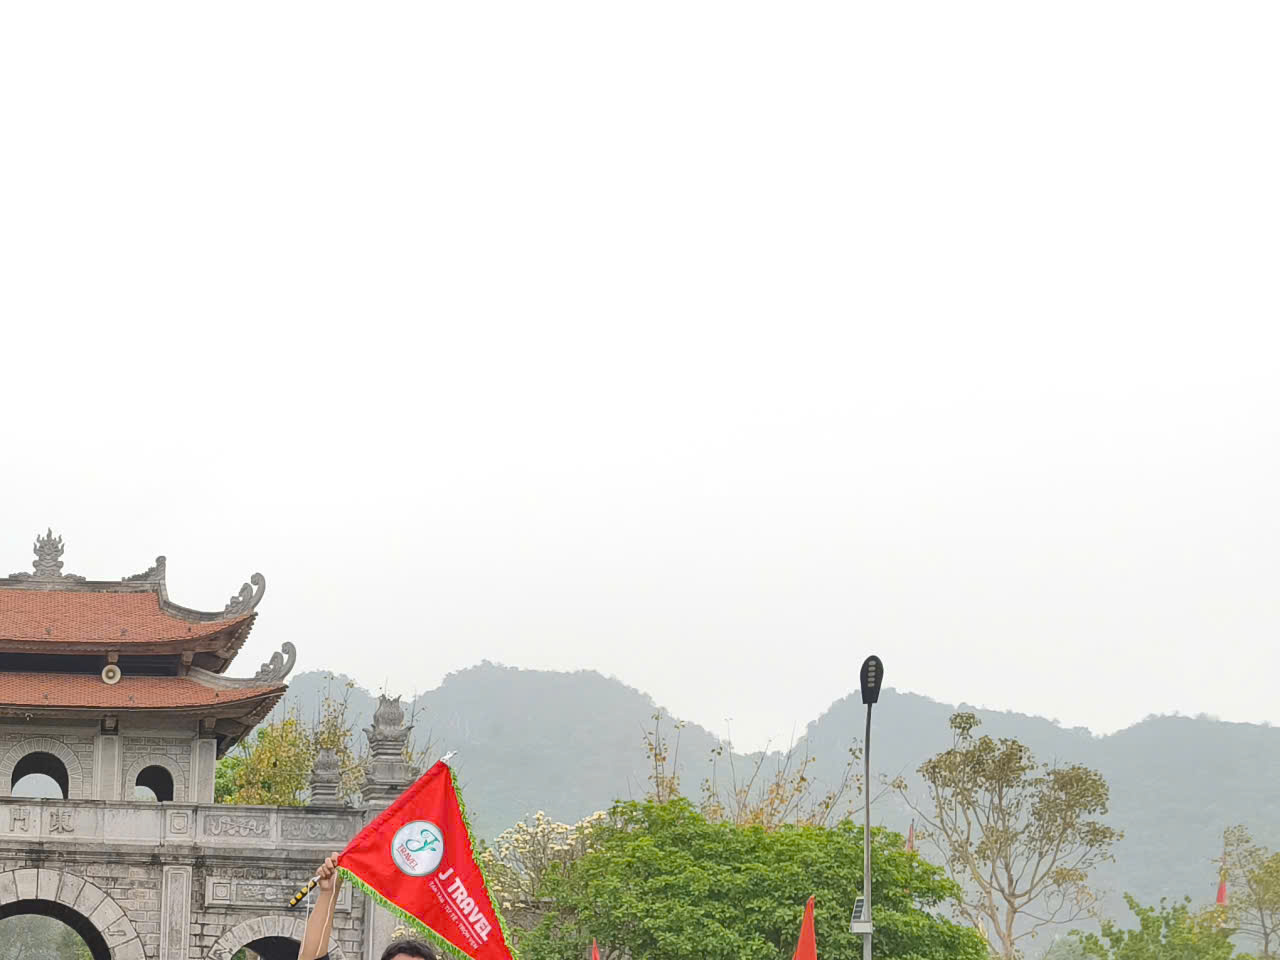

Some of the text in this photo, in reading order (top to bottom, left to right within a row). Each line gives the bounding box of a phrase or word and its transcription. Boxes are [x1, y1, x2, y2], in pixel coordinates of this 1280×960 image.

[397, 844, 419, 871] TRAVEL
[438, 867, 492, 942] J TRAVEL
